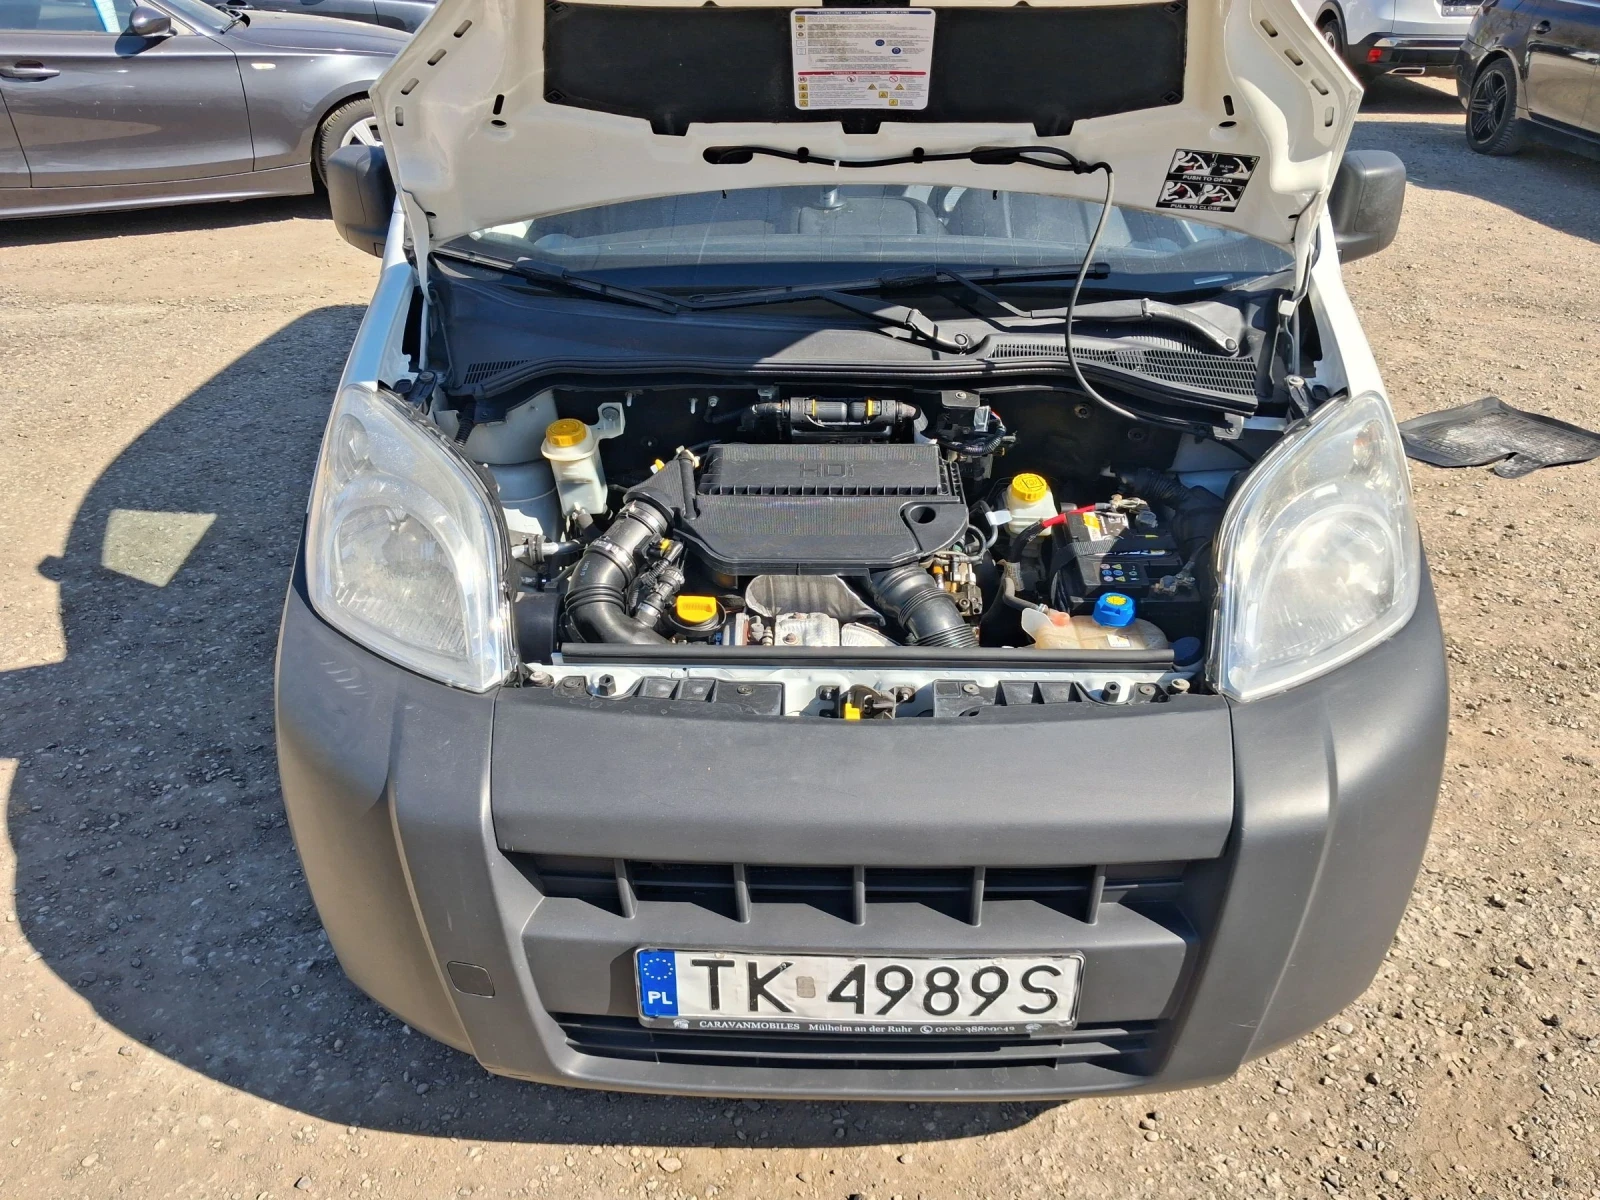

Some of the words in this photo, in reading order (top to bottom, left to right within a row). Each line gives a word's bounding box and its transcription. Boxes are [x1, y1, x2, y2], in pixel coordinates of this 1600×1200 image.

[691, 959, 795, 1013] TK
[827, 963, 1062, 1015] 4989S
[647, 990, 673, 1005] PL
[699, 1020, 800, 1030] CARAVANMOBILES
[808, 1023, 852, 1032] Mülheim
[869, 1025, 886, 1033] der
[888, 1025, 913, 1033] Ruhr
